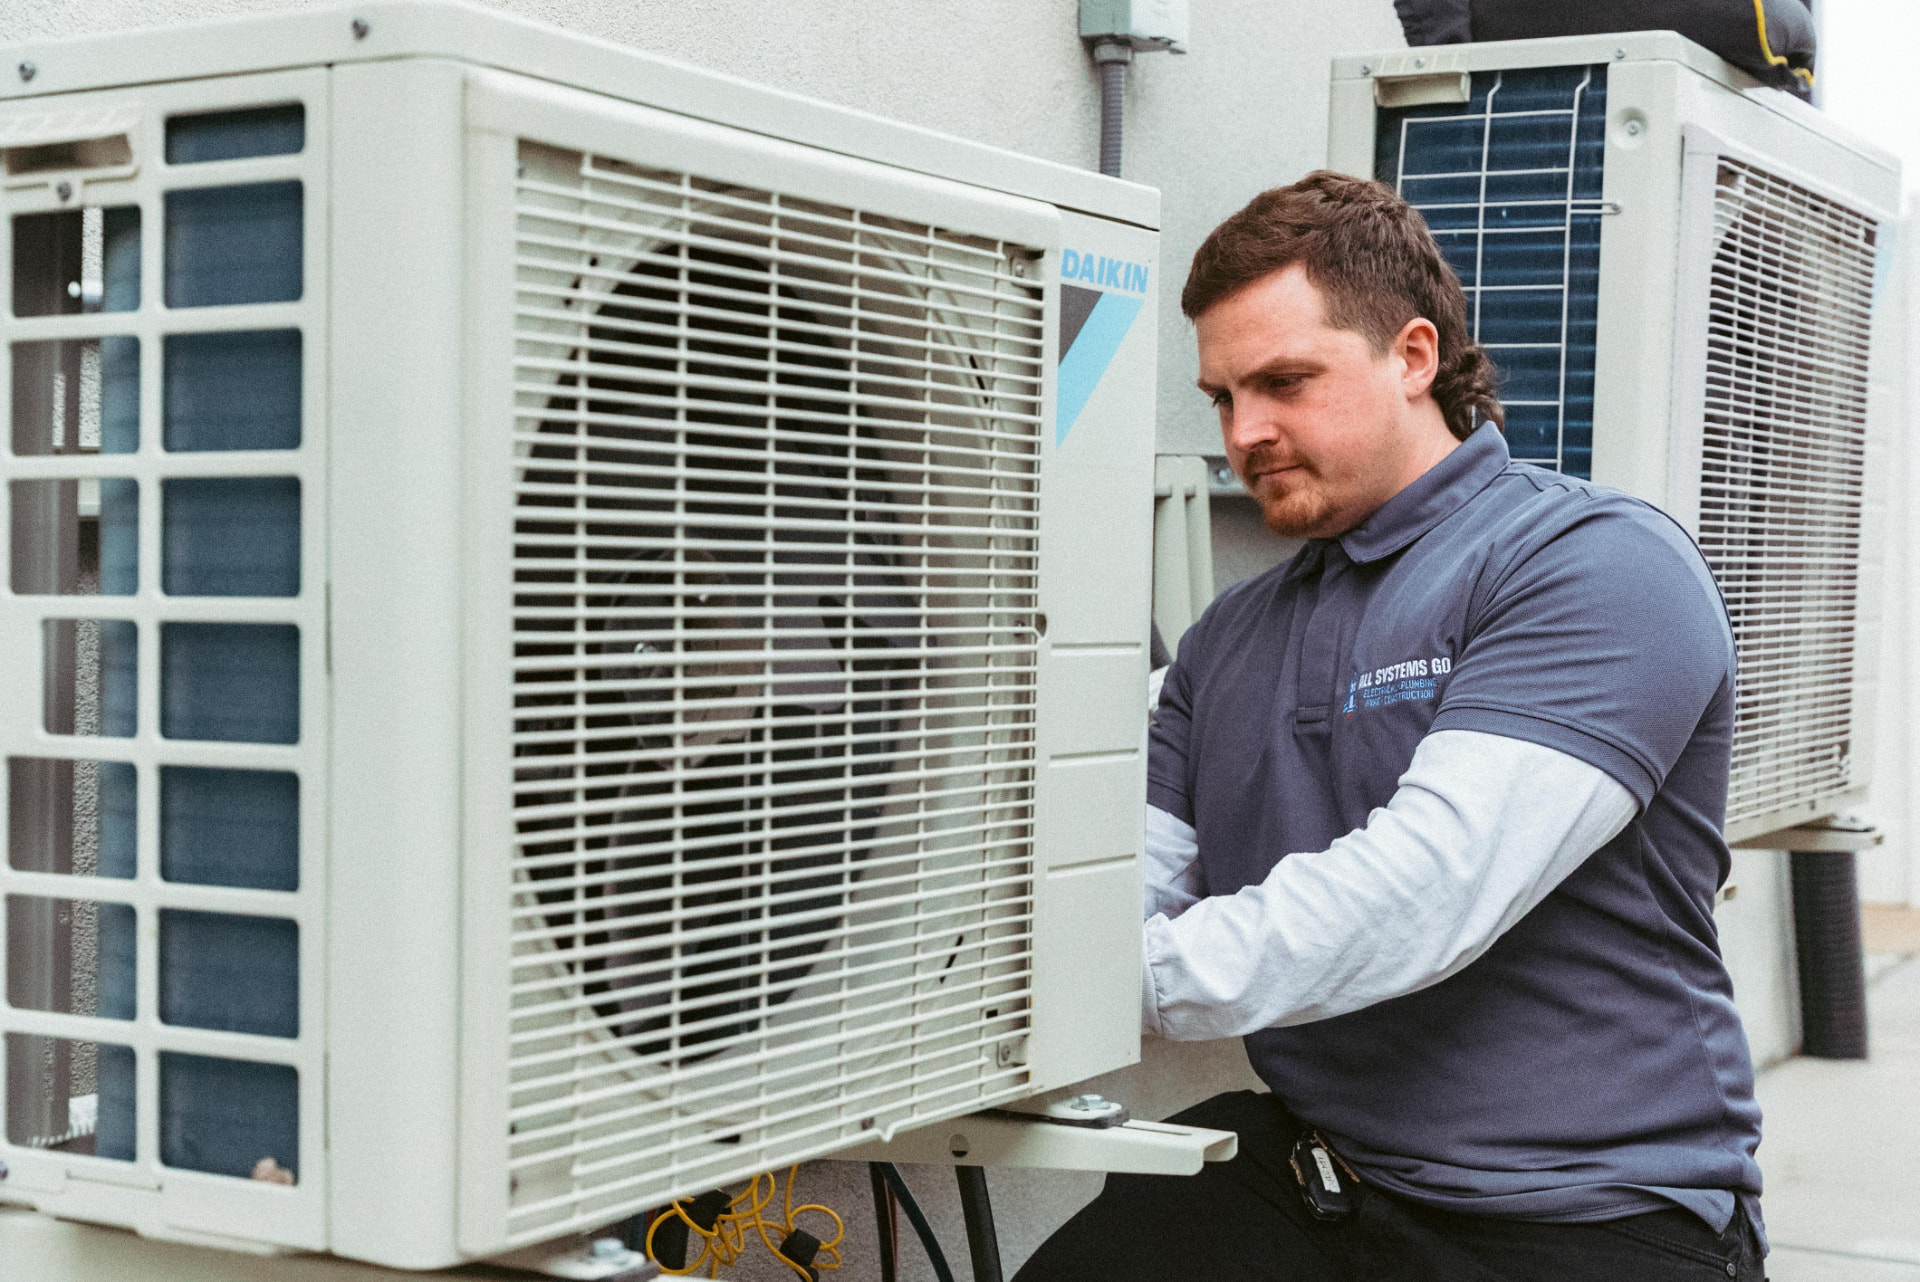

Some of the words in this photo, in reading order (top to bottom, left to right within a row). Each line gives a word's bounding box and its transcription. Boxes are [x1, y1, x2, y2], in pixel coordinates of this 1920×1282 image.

[1061, 248, 1148, 293] DAIKIN
[1358, 672, 1372, 690] ALL
[1375, 660, 1428, 685] SYSTEMS
[1431, 657, 1451, 675] GO
